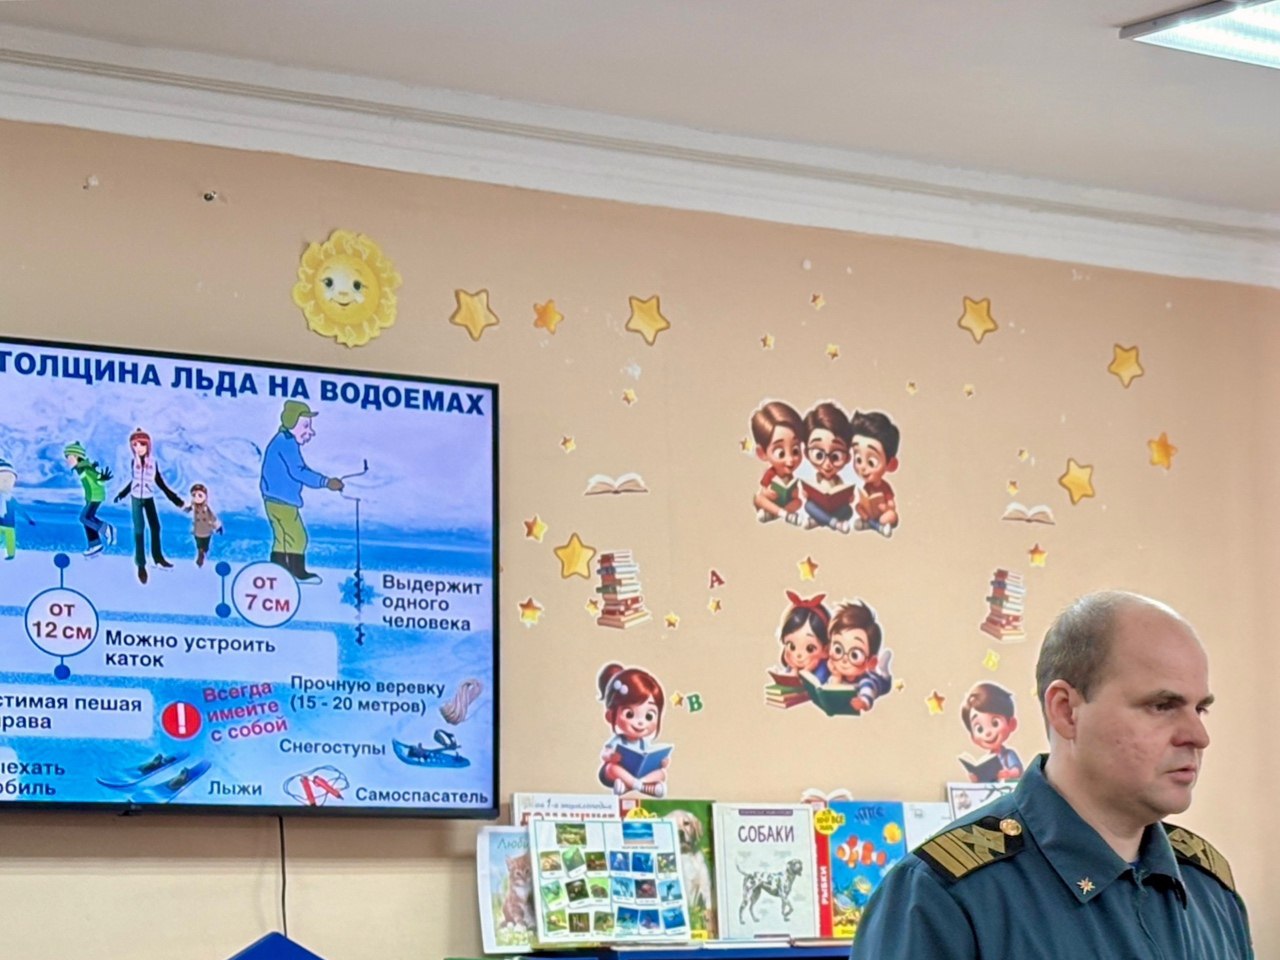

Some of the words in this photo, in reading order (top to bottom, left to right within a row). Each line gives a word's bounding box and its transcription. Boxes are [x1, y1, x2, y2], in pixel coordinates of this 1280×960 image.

[0, 350, 161, 386] ТОЛЩИНА
[171, 366, 258, 397] ЛЬДА
[268, 375, 310, 399] НА
[320, 380, 484, 416] ВОДОЕМАХ
[382, 574, 483, 596] Выдержит
[245, 594, 258, 610] 7
[262, 598, 290, 612] см
[382, 596, 449, 611] одного
[32, 621, 58, 639] 12
[62, 625, 92, 640] см
[382, 615, 471, 631] человека
[105, 630, 178, 648] Можно
[184, 637, 276, 654] устроить
[105, 653, 164, 668] каток
[203, 682, 272, 703] Всегда
[291, 675, 370, 693] Прочную
[376, 680, 446, 697] веревку
[0, 695, 68, 710] тимая
[75, 697, 142, 712] пешая
[207, 700, 279, 723] имейте
[290, 694, 316, 711] (15
[333, 696, 351, 710] 20
[358, 699, 426, 716] метров)
[0, 714, 51, 732] рава
[211, 729, 221, 741] с
[228, 716, 288, 738] собой
[279, 738, 386, 758] Снегоступы
[0, 779, 56, 796] биль
[208, 781, 262, 796] Лыжи
[356, 787, 488, 803] Самоспасатель
[738, 825, 795, 843] СОБАКИ
